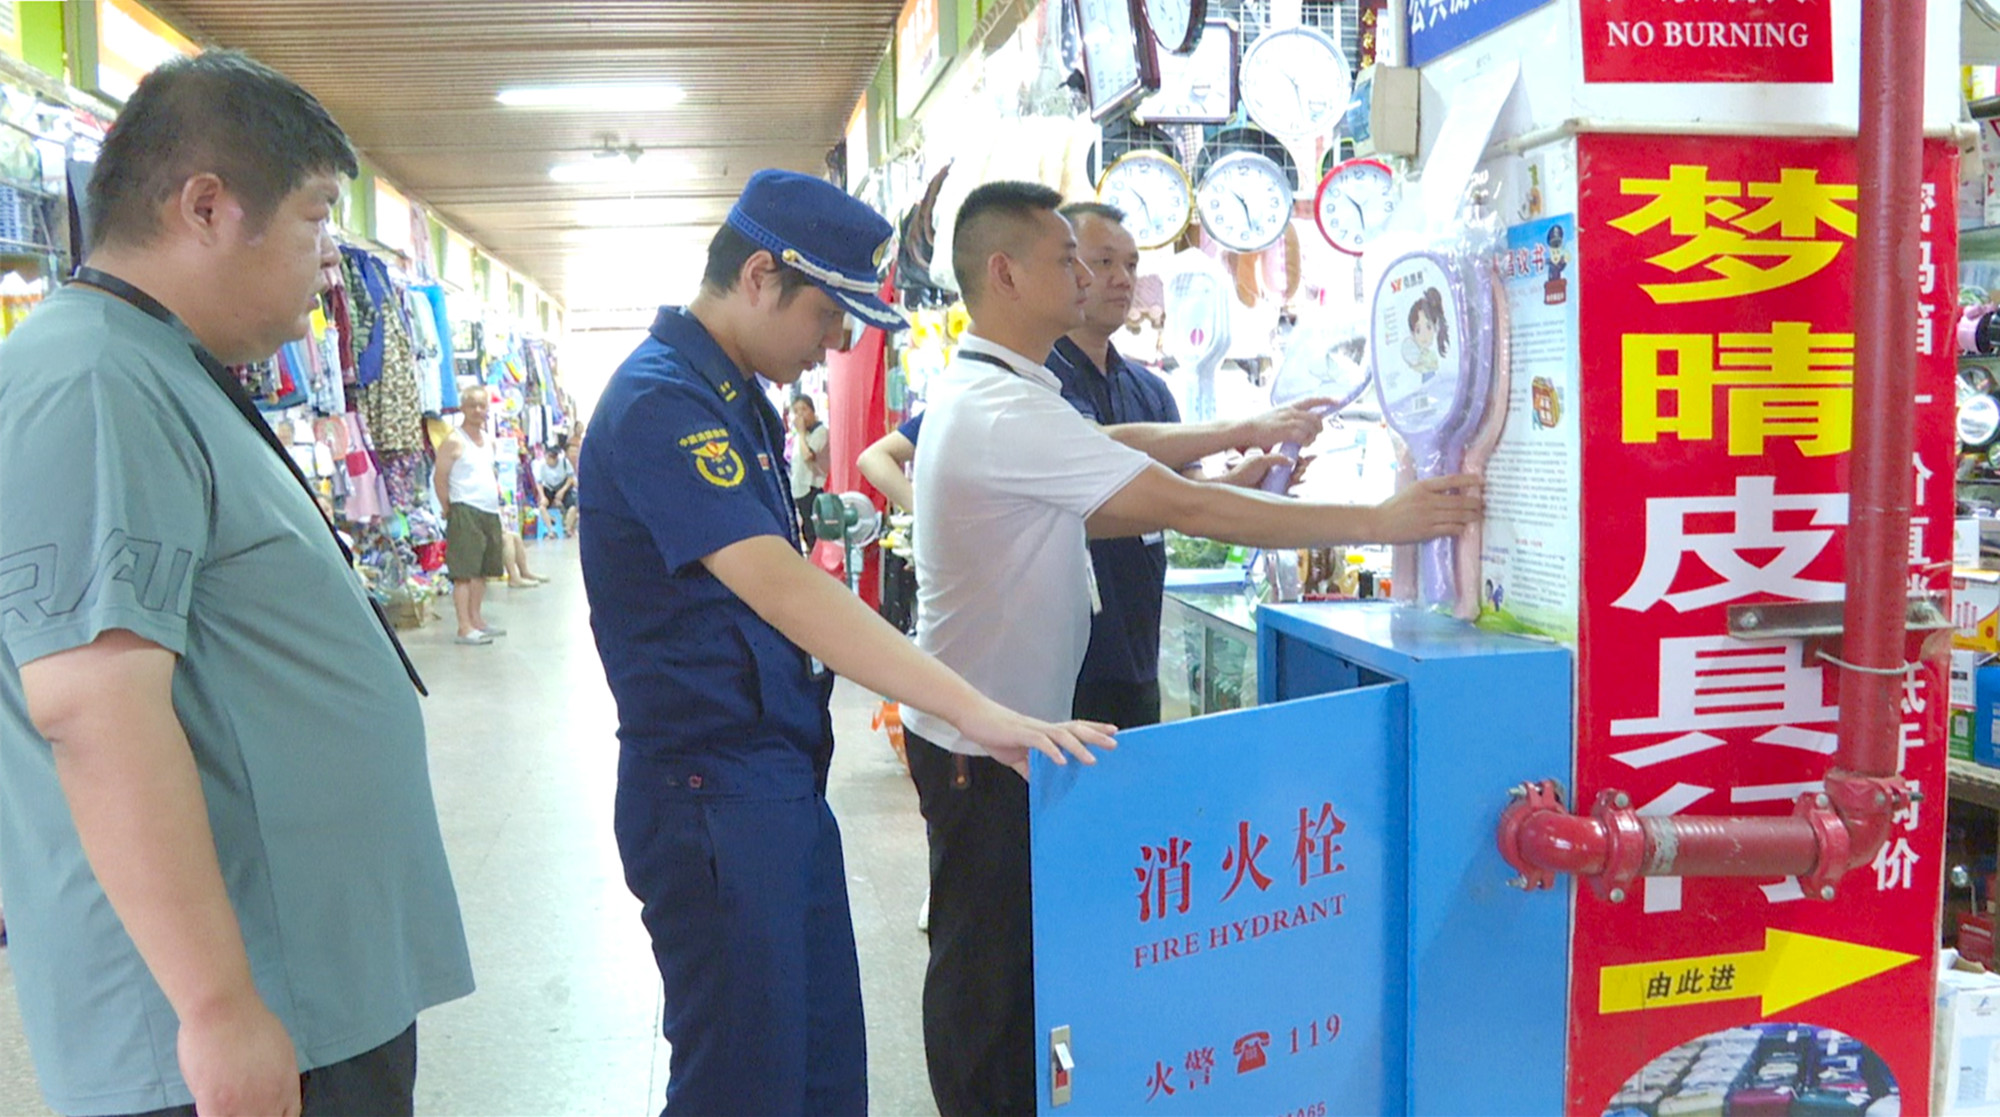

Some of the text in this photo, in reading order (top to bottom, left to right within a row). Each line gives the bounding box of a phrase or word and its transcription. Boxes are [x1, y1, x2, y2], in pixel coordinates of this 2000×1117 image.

[1607, 21, 1809, 47] NO BURNING
[1134, 802, 1347, 923] 消火栓
[1134, 893, 1347, 969] FIRE HYDRANT
[1647, 964, 1735, 999] 由此进
[1146, 1014, 1341, 1103] 火警 119
